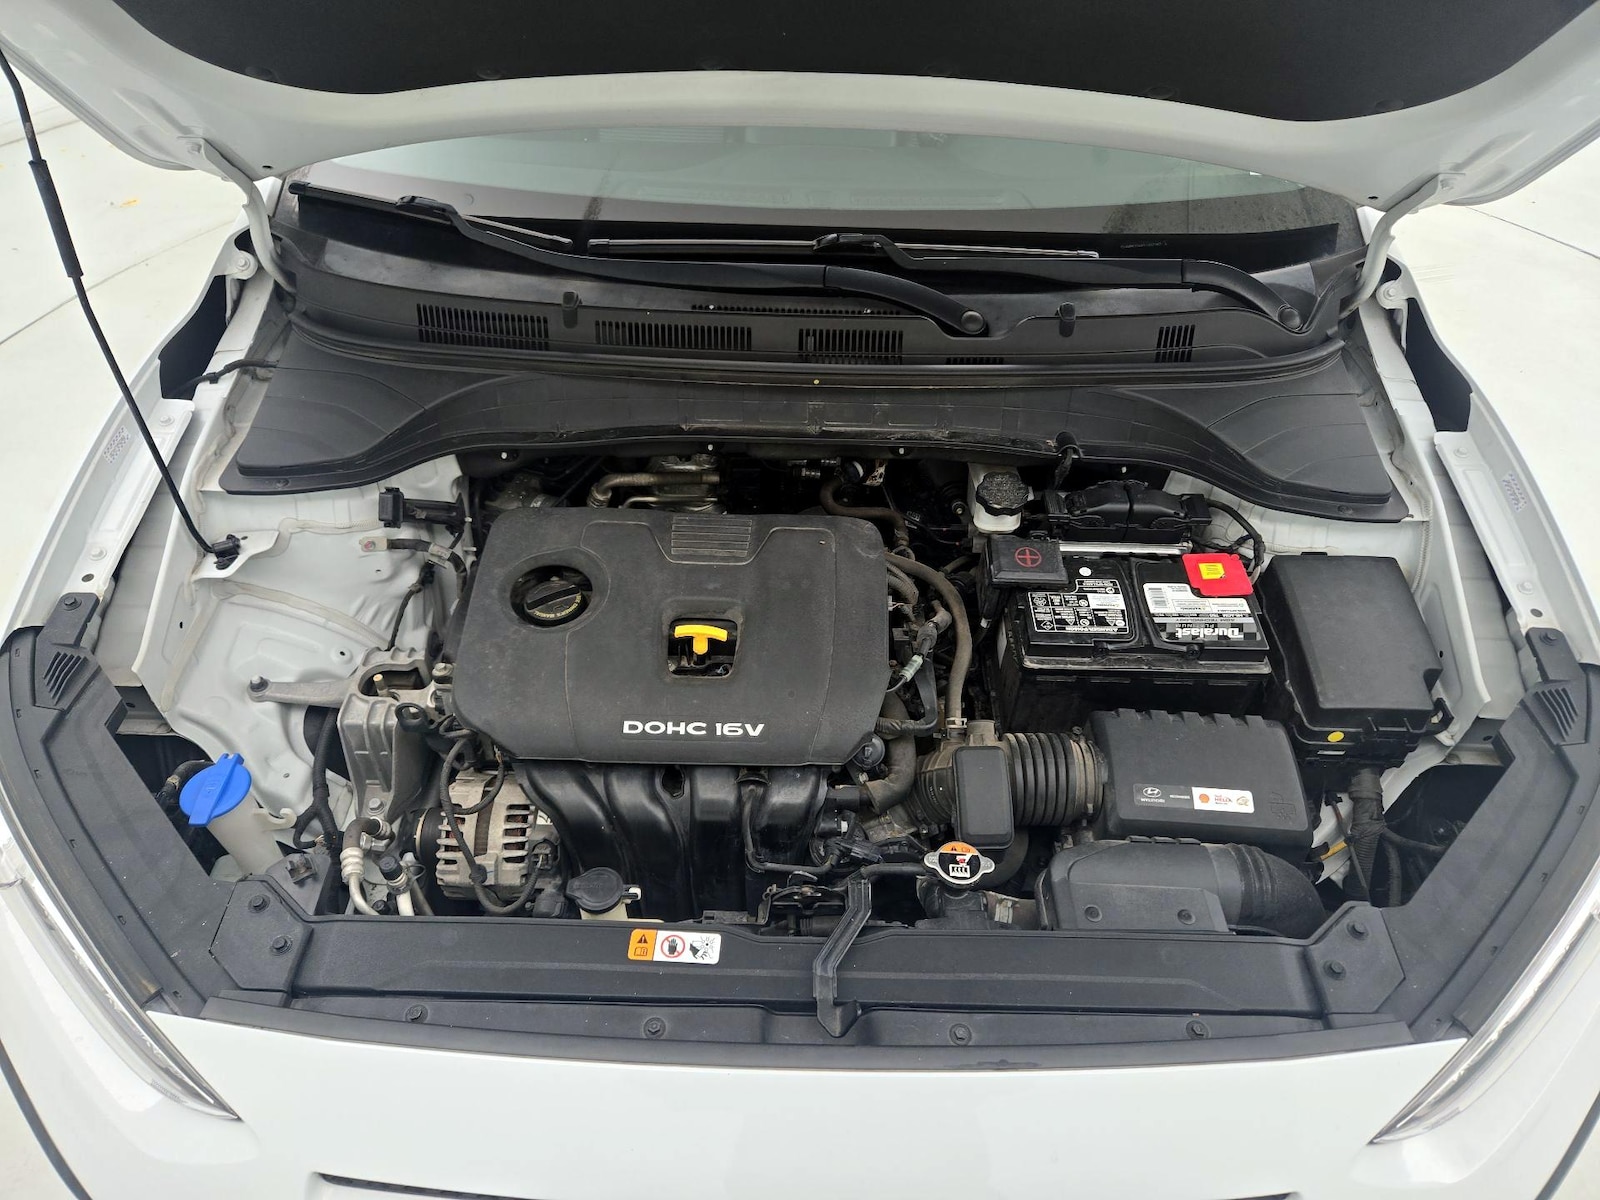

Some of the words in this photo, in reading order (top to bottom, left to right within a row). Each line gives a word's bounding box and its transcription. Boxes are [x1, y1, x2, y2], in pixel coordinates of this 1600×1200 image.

[1175, 627, 1244, 639] Duralast
[622, 720, 707, 735] DOHC
[715, 722, 765, 737] 16V
